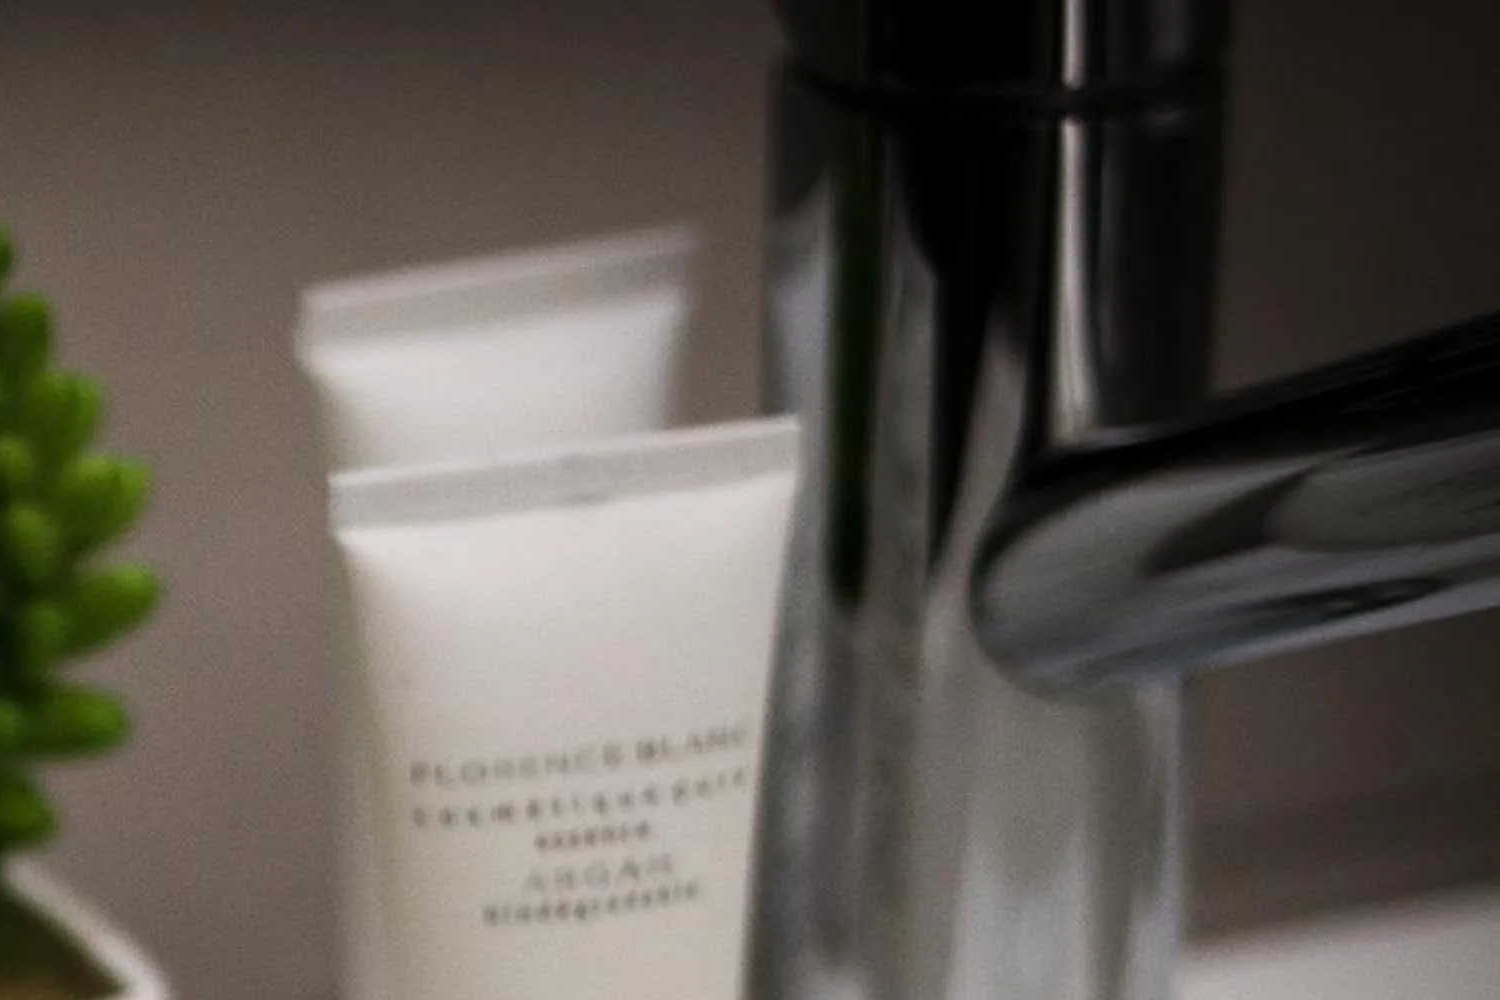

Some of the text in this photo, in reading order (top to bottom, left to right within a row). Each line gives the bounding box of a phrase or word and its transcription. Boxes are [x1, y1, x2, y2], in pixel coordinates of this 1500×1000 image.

[408, 722, 746, 788] FLORENCE BLANC
[532, 818, 650, 852] essence
[522, 852, 673, 890] ARGAN
